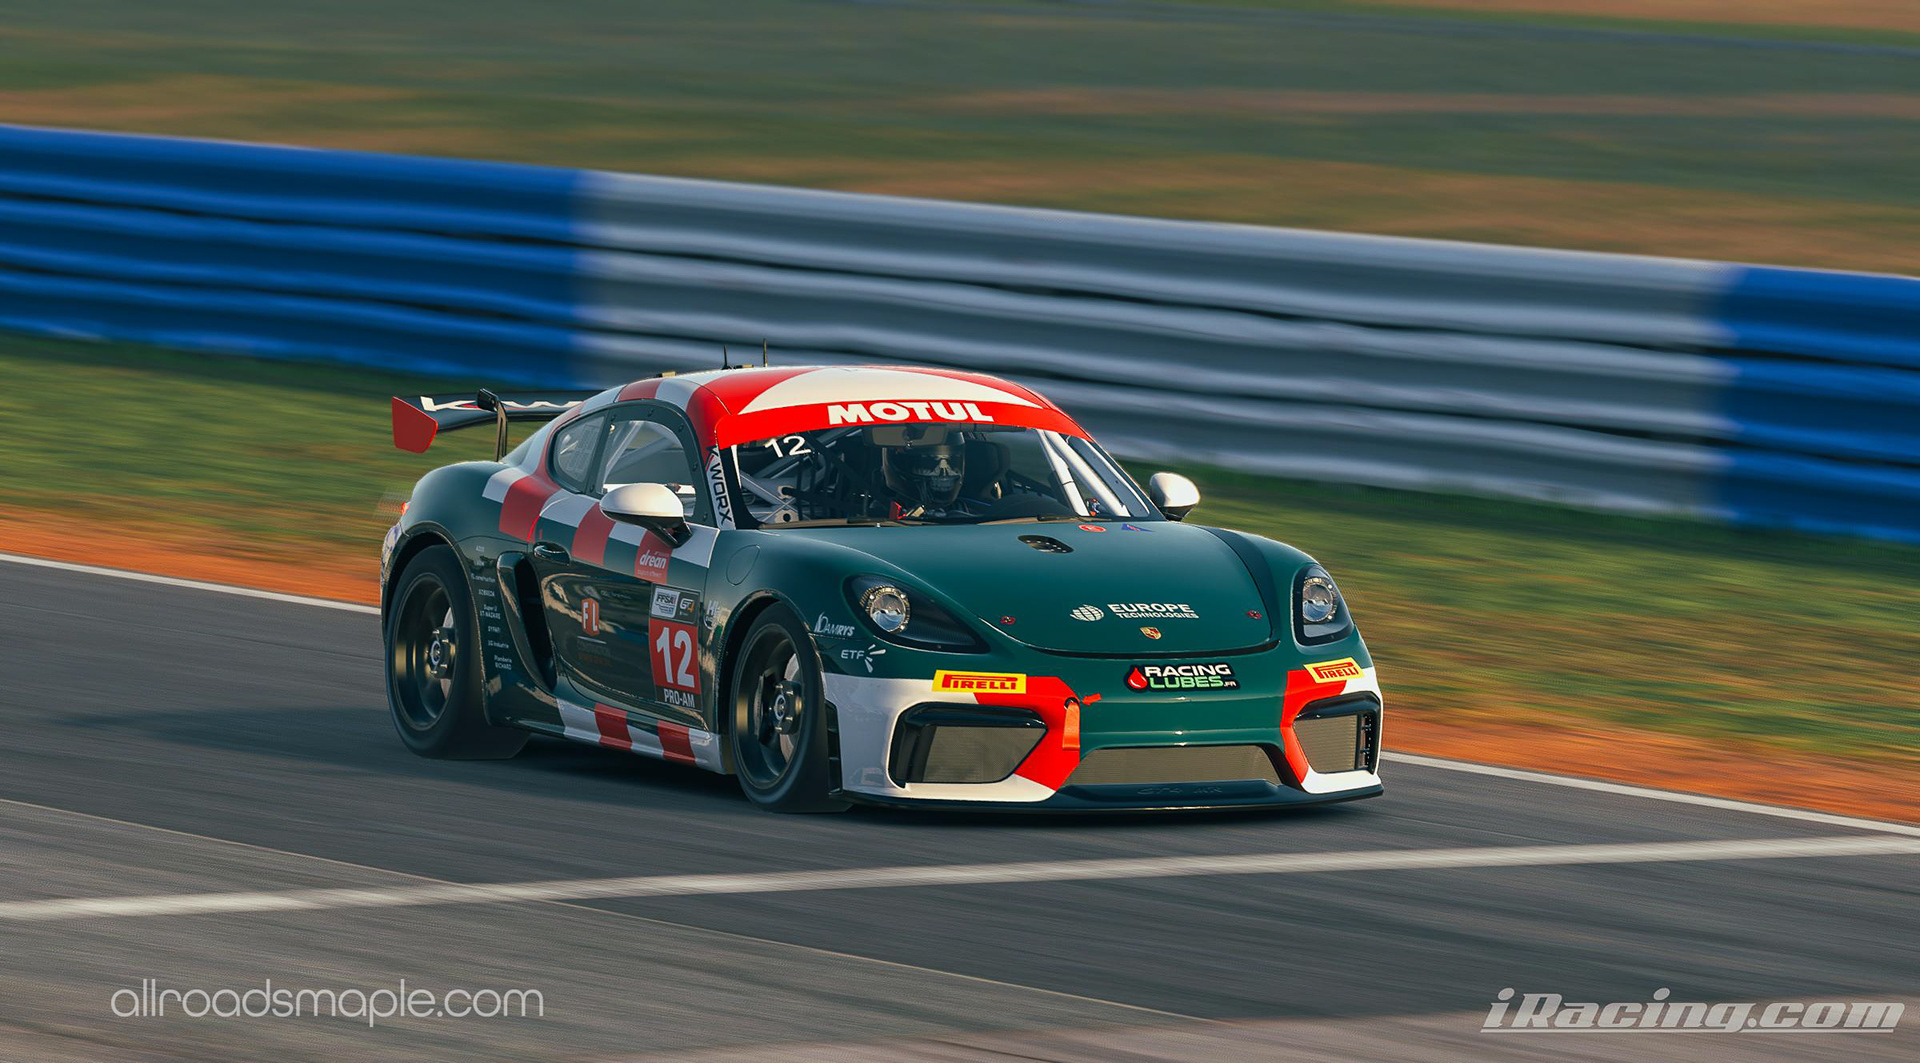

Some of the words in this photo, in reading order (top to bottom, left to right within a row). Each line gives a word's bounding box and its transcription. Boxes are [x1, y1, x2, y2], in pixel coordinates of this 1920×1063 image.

[827, 402, 994, 425] MOTUL
[764, 435, 811, 458] 12
[710, 462, 733, 526] WORX
[1107, 603, 1195, 613] EUROPE
[656, 626, 695, 688] 12
[840, 649, 865, 660] ETF
[1144, 664, 1232, 677] RACING
[1312, 662, 1360, 679] PIRELLI
[941, 674, 1018, 690] PIRELLI
[664, 688, 695, 708] PRO-AM
